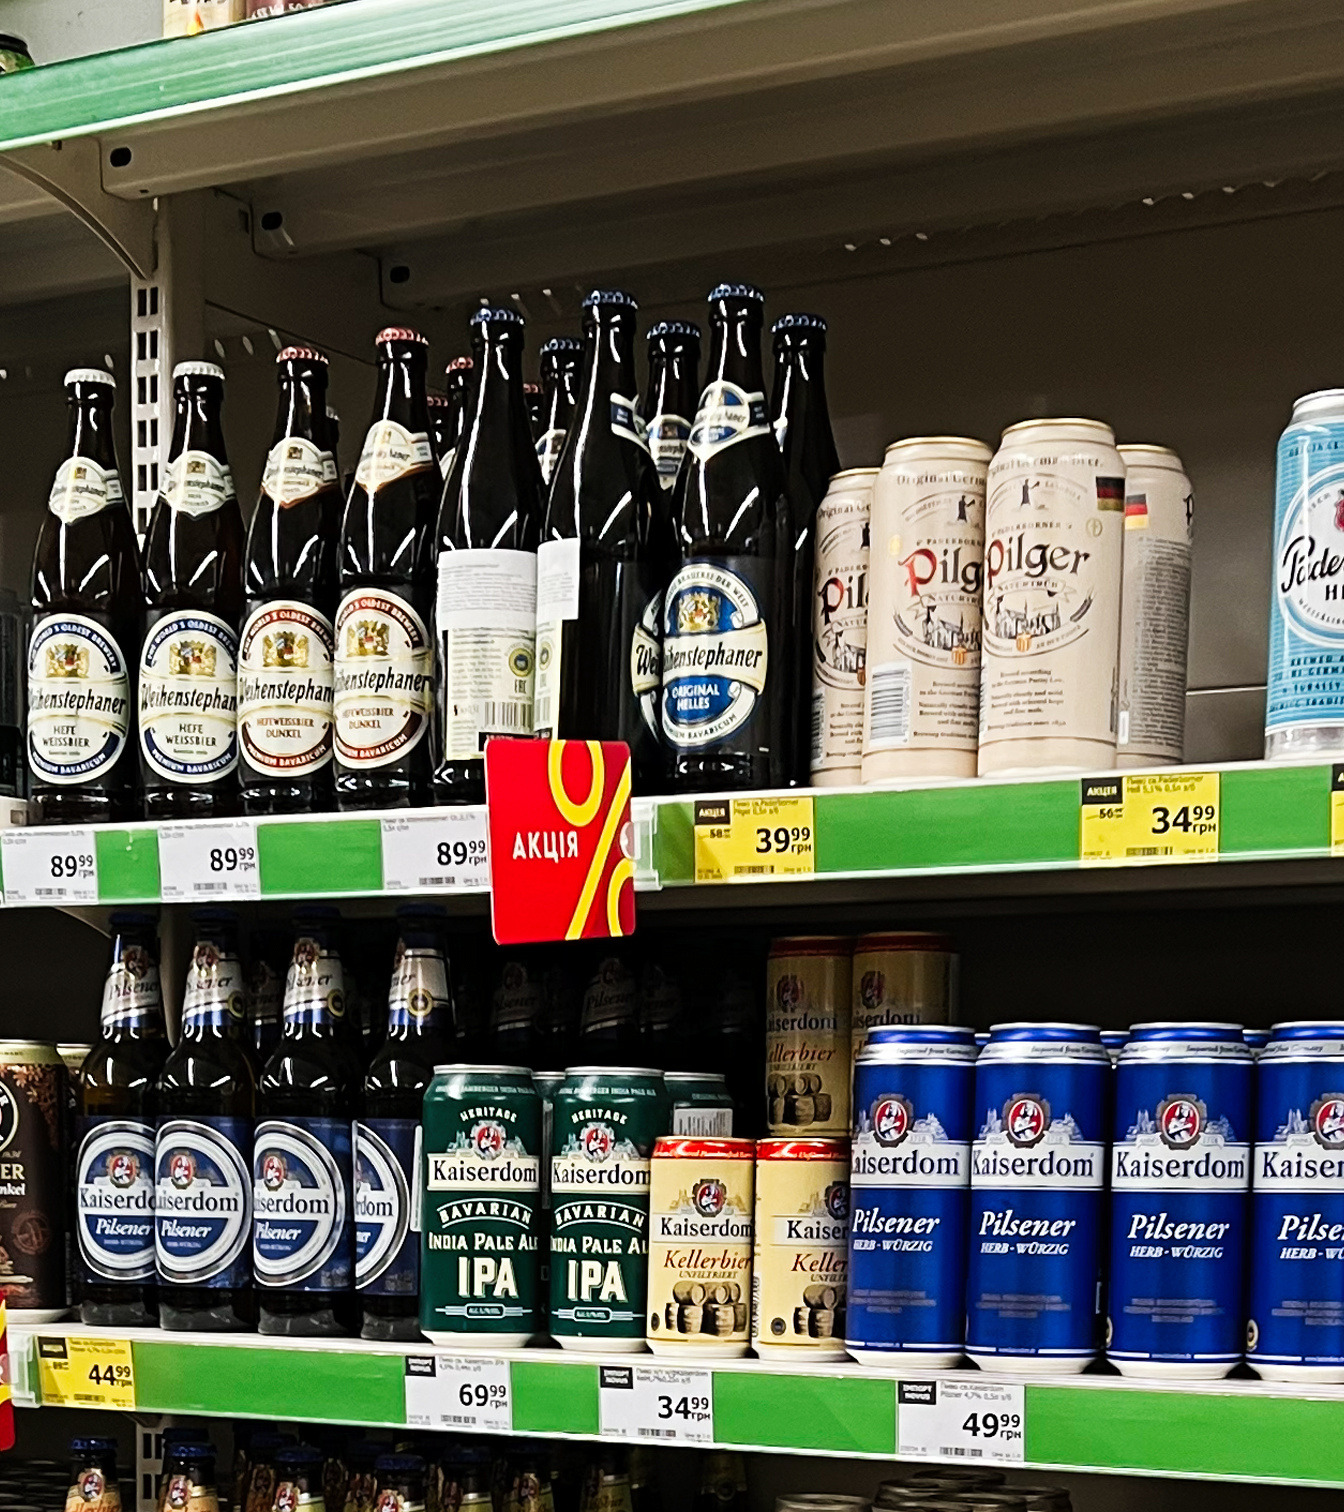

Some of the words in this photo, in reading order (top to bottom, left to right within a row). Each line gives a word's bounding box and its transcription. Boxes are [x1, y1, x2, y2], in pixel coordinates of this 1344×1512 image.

[984, 536, 1092, 578] Pilger
[671, 683, 720, 700] ORIGINAL
[52, 725, 76, 738] HEFE
[178, 723, 205, 735] HEFE
[1151, 806, 1192, 835] 34
[1192, 806, 1215, 822] 99
[512, 830, 580, 861] АКЦІЯ
[755, 827, 789, 854] 39
[790, 827, 811, 842] 99
[50, 854, 77, 879] 89
[209, 847, 238, 872] 89
[435, 841, 467, 867] 89
[459, 1108, 518, 1124] HERITAGE
[432, 1158, 537, 1186] Kaiserdom
[971, 1147, 1095, 1180] Kaiserdom
[1115, 1149, 1246, 1181] Kaiserdom
[438, 1201, 532, 1226] BAVARIAN
[979, 1211, 1075, 1241] Pilsener
[474, 1232, 515, 1251] PALE
[1127, 1214, 1230, 1244] Pilsener
[663, 1248, 752, 1273] Kellerbier
[457, 1258, 518, 1300] IPA
[567, 1260, 627, 1304] IPA
[88, 1363, 115, 1387] 44
[458, 1384, 486, 1409] 69
[487, 1384, 507, 1398] 99
[657, 1395, 688, 1421] 34
[689, 1397, 709, 1411] 99
[962, 1412, 999, 1439] 49
[1000, 1414, 1021, 1429] 99
